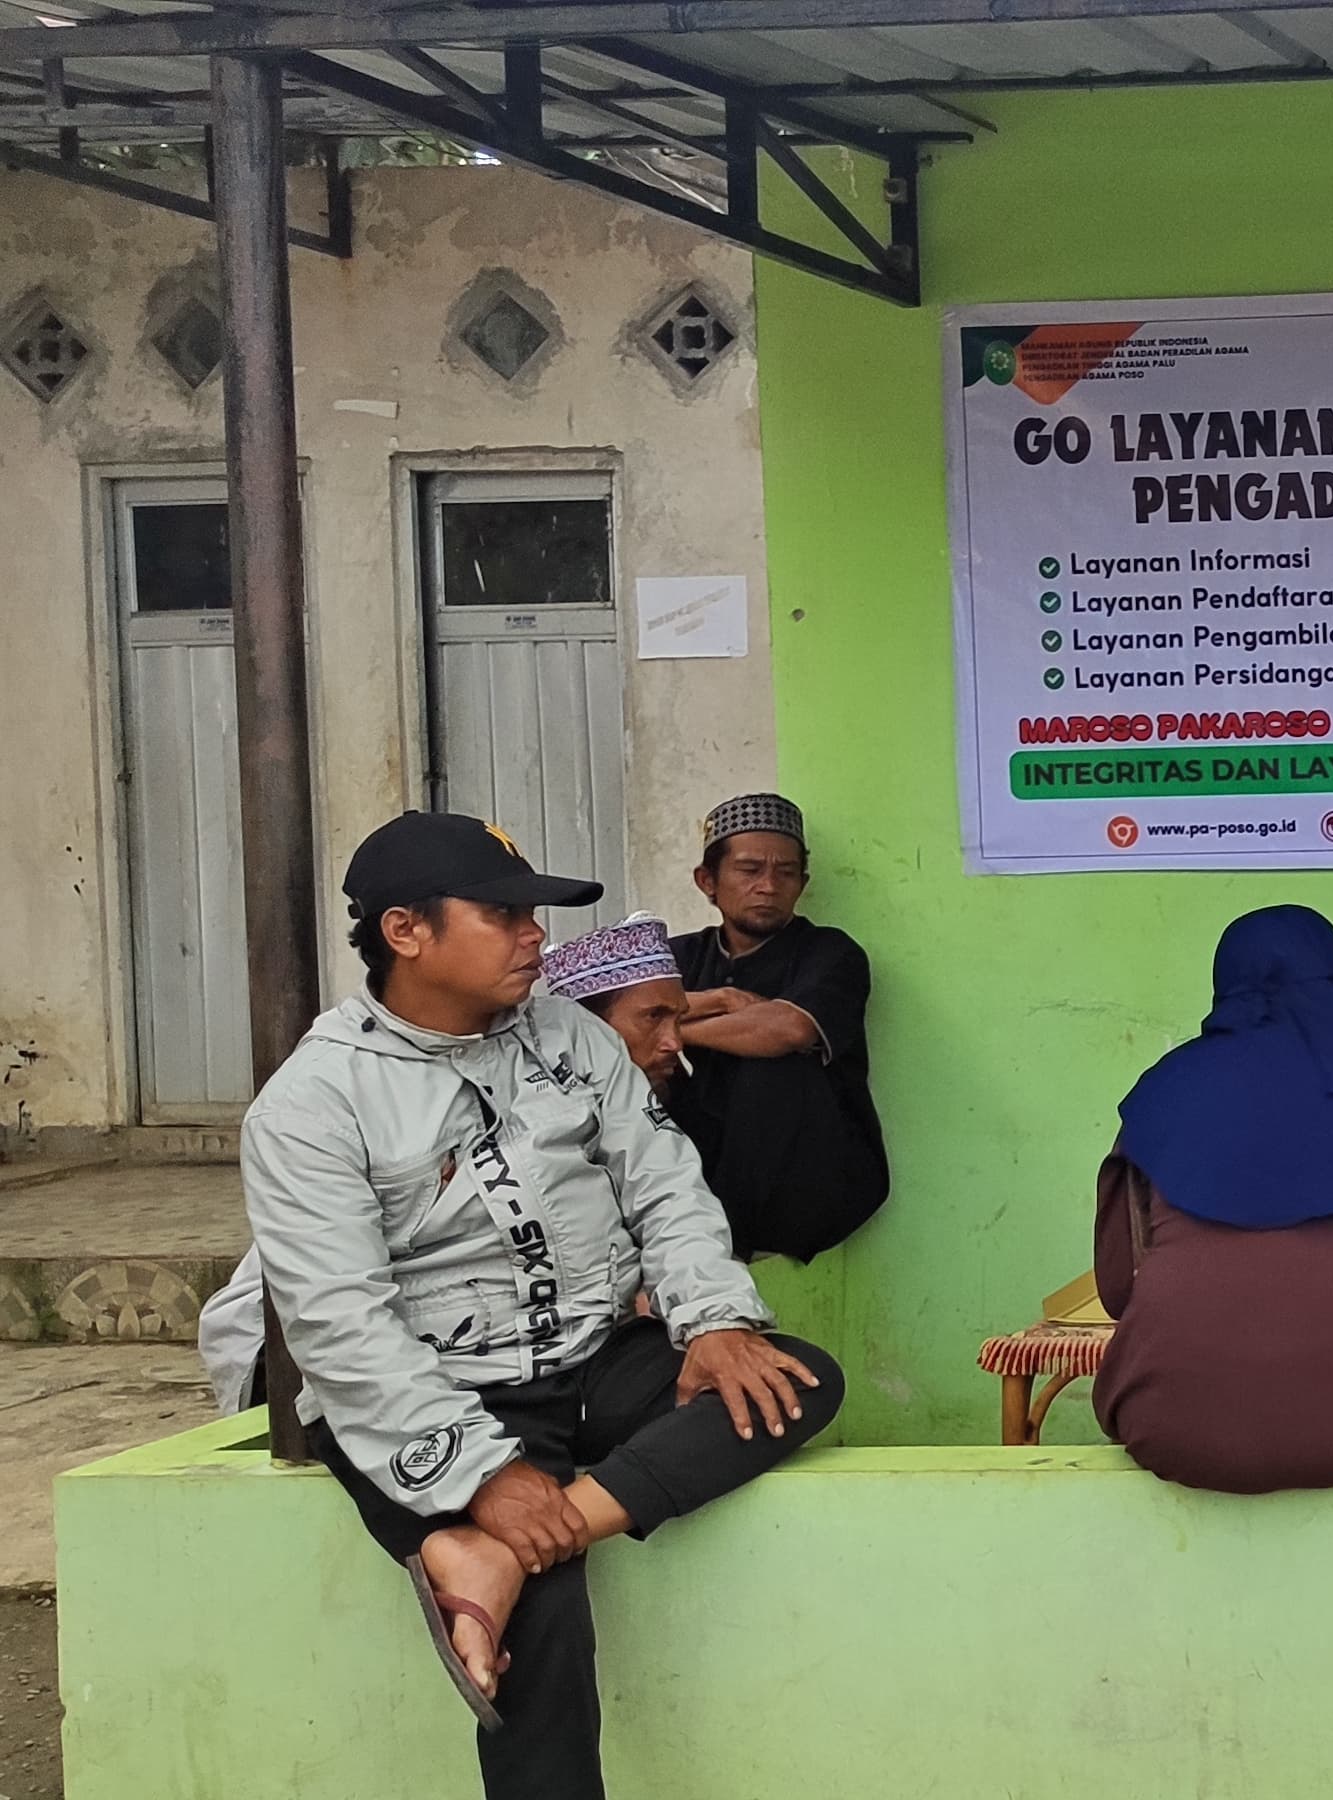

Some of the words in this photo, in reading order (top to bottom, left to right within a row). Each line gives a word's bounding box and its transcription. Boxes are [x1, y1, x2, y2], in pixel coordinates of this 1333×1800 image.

[1127, 348, 1160, 358] BADAN
[1162, 347, 1213, 357] PERADILAN
[1214, 345, 1249, 355] AGAMA
[1158, 336, 1209, 346] INDONESIA
[1081, 371, 1117, 381] AGAMA
[1118, 370, 1145, 380] POSO
[1115, 360, 1151, 369] AGAMA
[1152, 358, 1176, 368] PALU
[1012, 415, 1092, 466] GO
[1070, 550, 1181, 580] Layanan
[1189, 546, 1312, 573] Informasi
[1071, 589, 1183, 618] Layanan
[1072, 627, 1184, 656] Layanan
[1075, 665, 1186, 695] Layanan
[1018, 712, 1154, 745] MAROSO
[1156, 709, 1333, 742] PAKAROSO
[1024, 759, 1204, 787] INTEGRITAS
[1213, 756, 1281, 783] DAN
[1146, 818, 1298, 841] www.pa-poso.go.id
